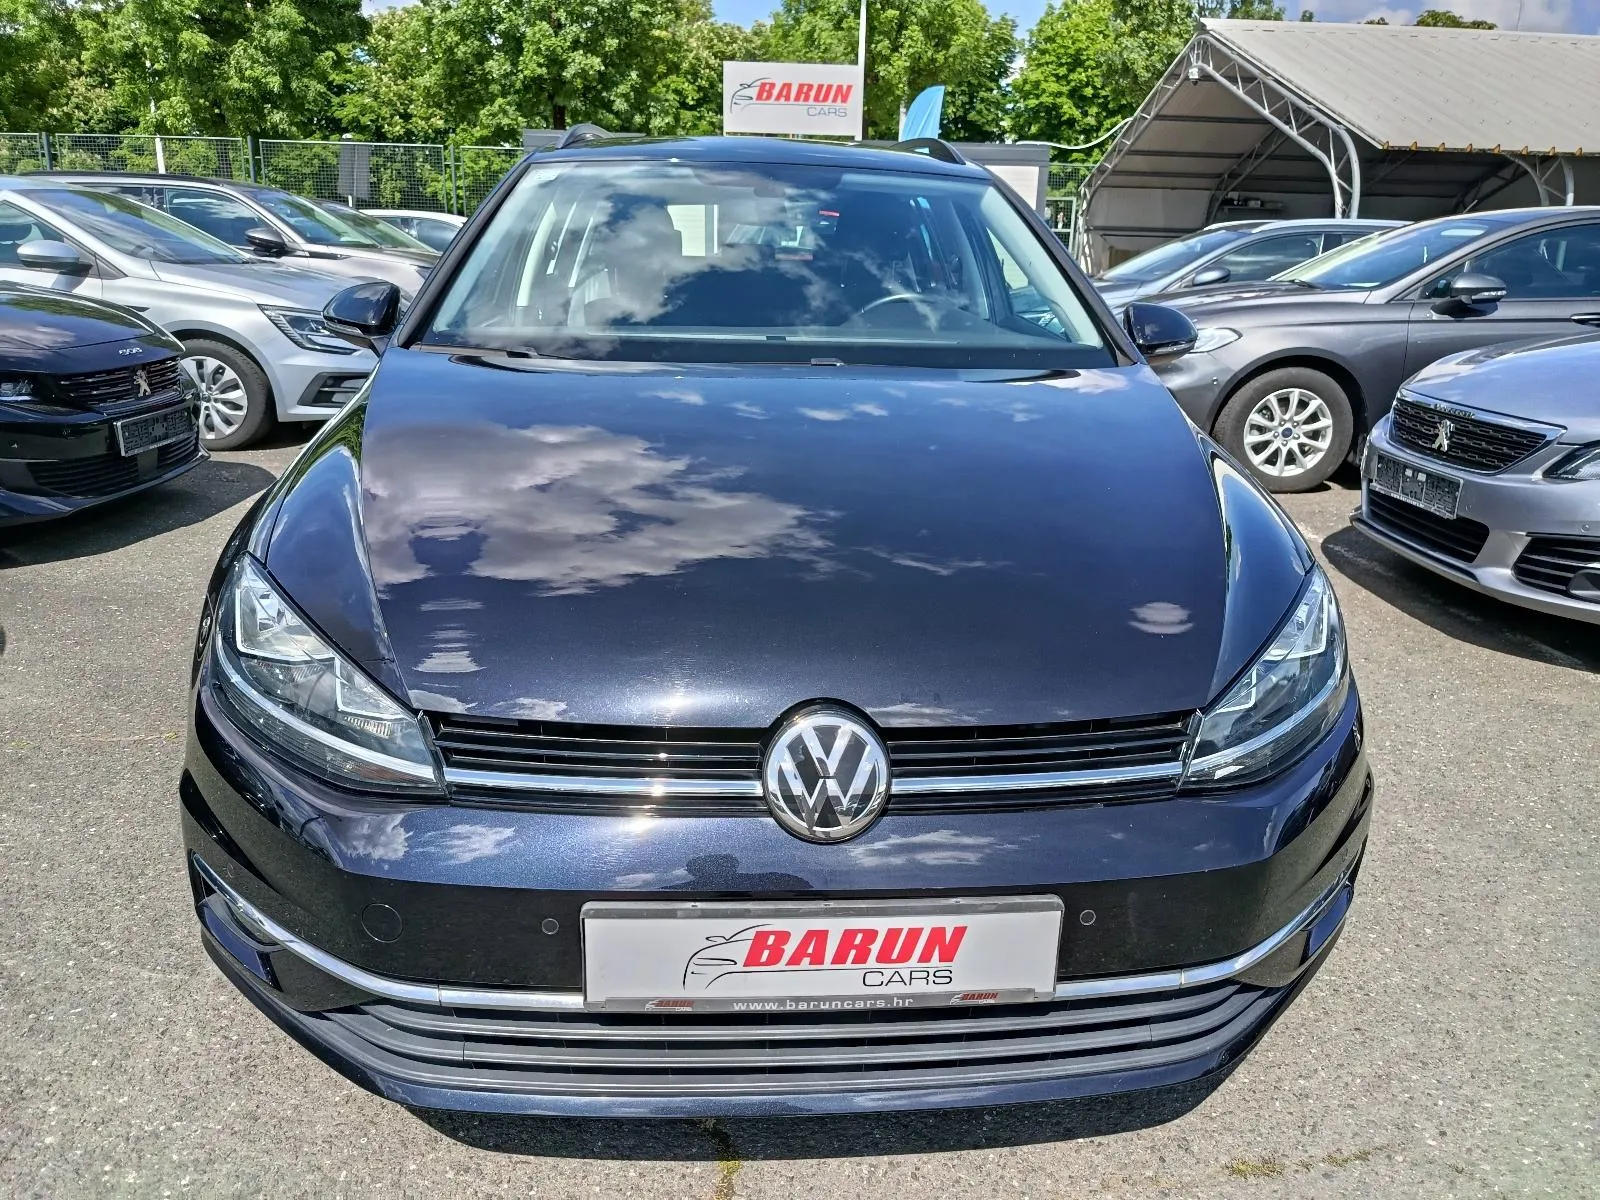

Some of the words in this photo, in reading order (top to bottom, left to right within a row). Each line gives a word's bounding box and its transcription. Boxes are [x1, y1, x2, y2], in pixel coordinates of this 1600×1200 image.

[756, 82, 853, 104] BARUN
[807, 106, 848, 118] CARS
[743, 926, 968, 967] BARUN
[862, 969, 953, 987] CARS
[733, 996, 914, 1011] www.baruncars.hr
